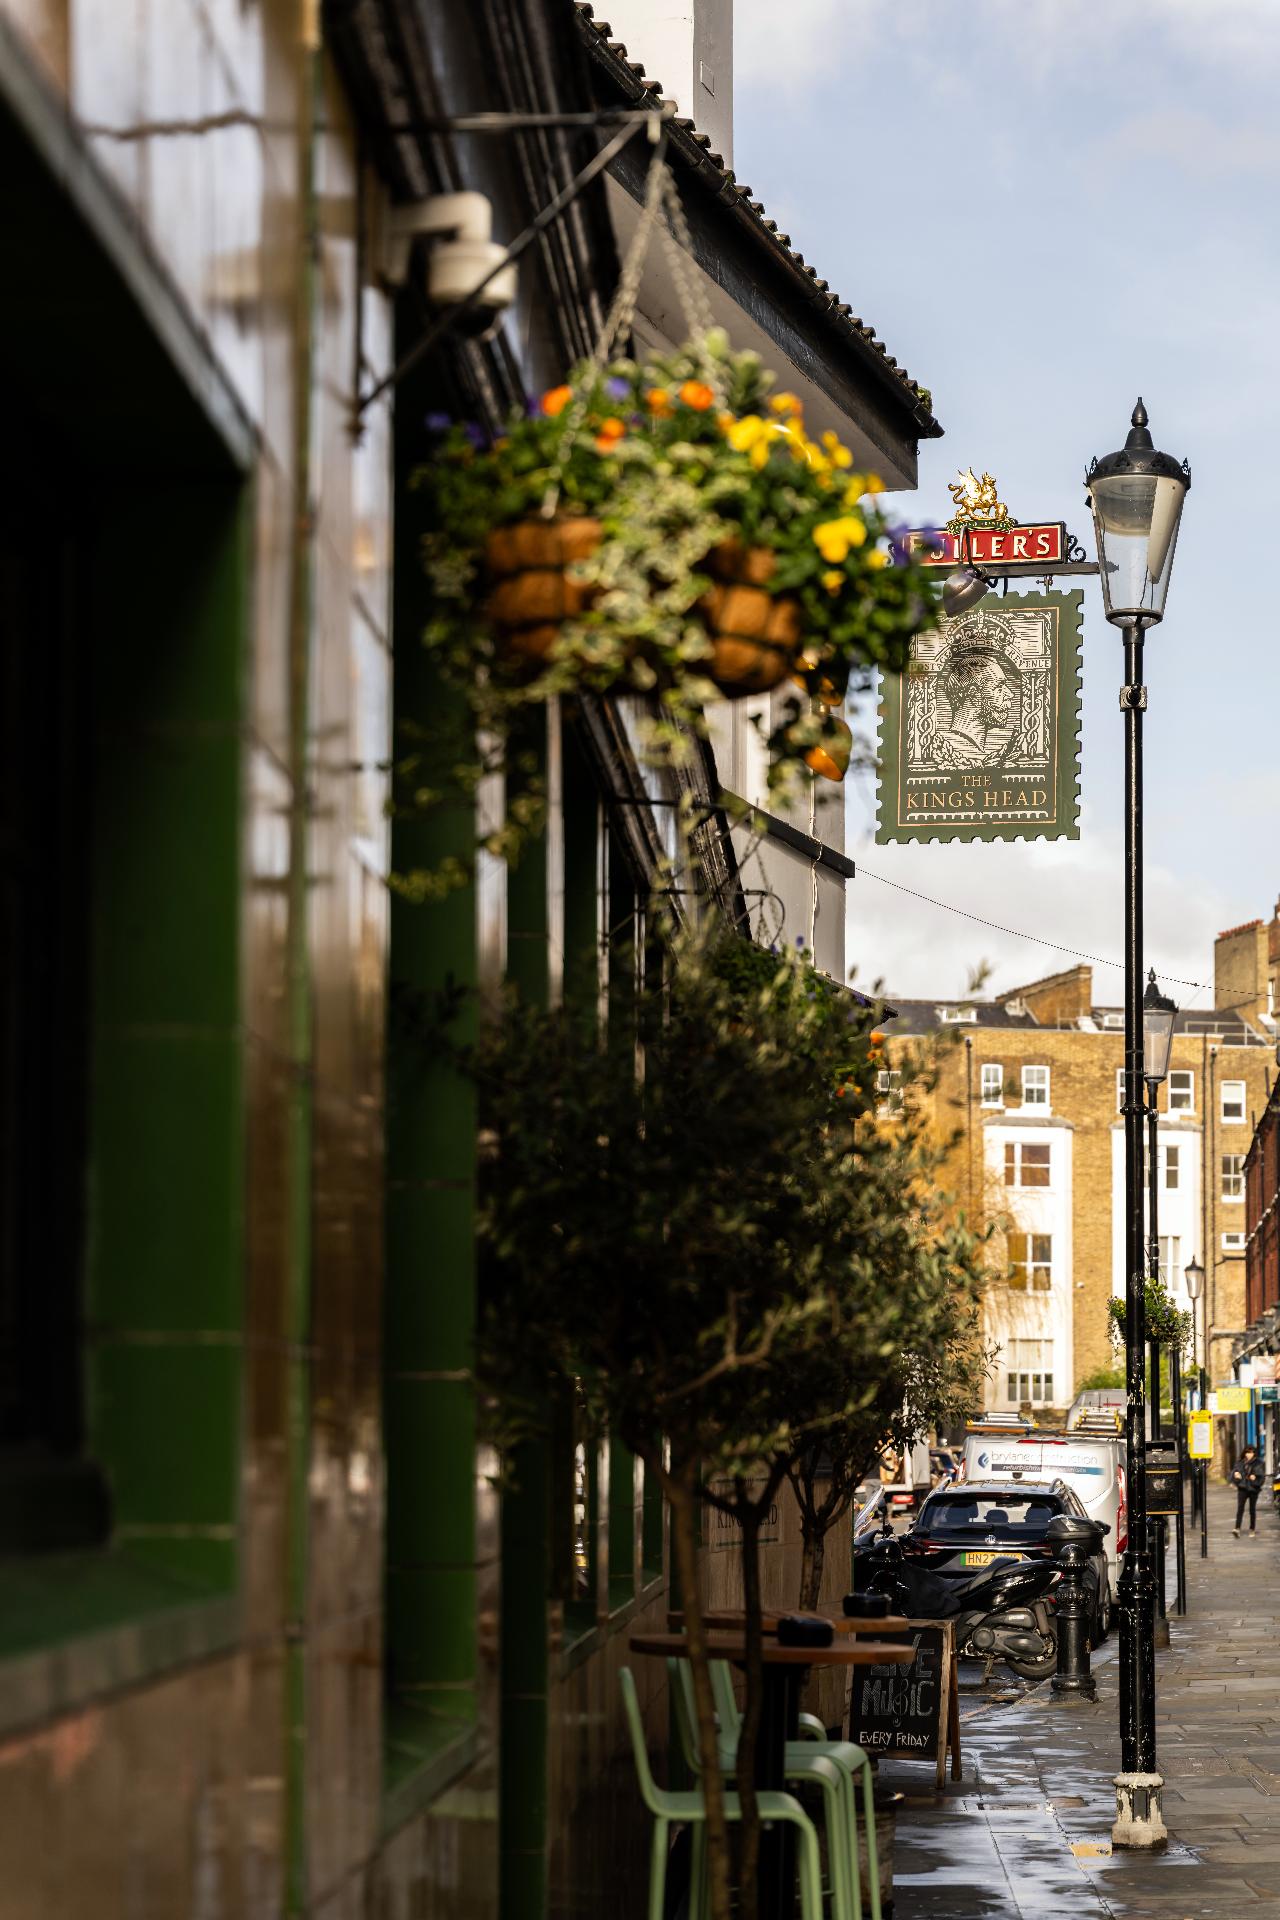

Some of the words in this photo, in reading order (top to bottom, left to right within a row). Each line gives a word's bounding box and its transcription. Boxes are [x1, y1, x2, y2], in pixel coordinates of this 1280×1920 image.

[961, 775, 992, 787] THE
[906, 791, 975, 809] KINGS
[983, 790, 1047, 807] HEAD
[859, 1731, 892, 1746] EVERY
[896, 1732, 930, 1748] FRIDAY
